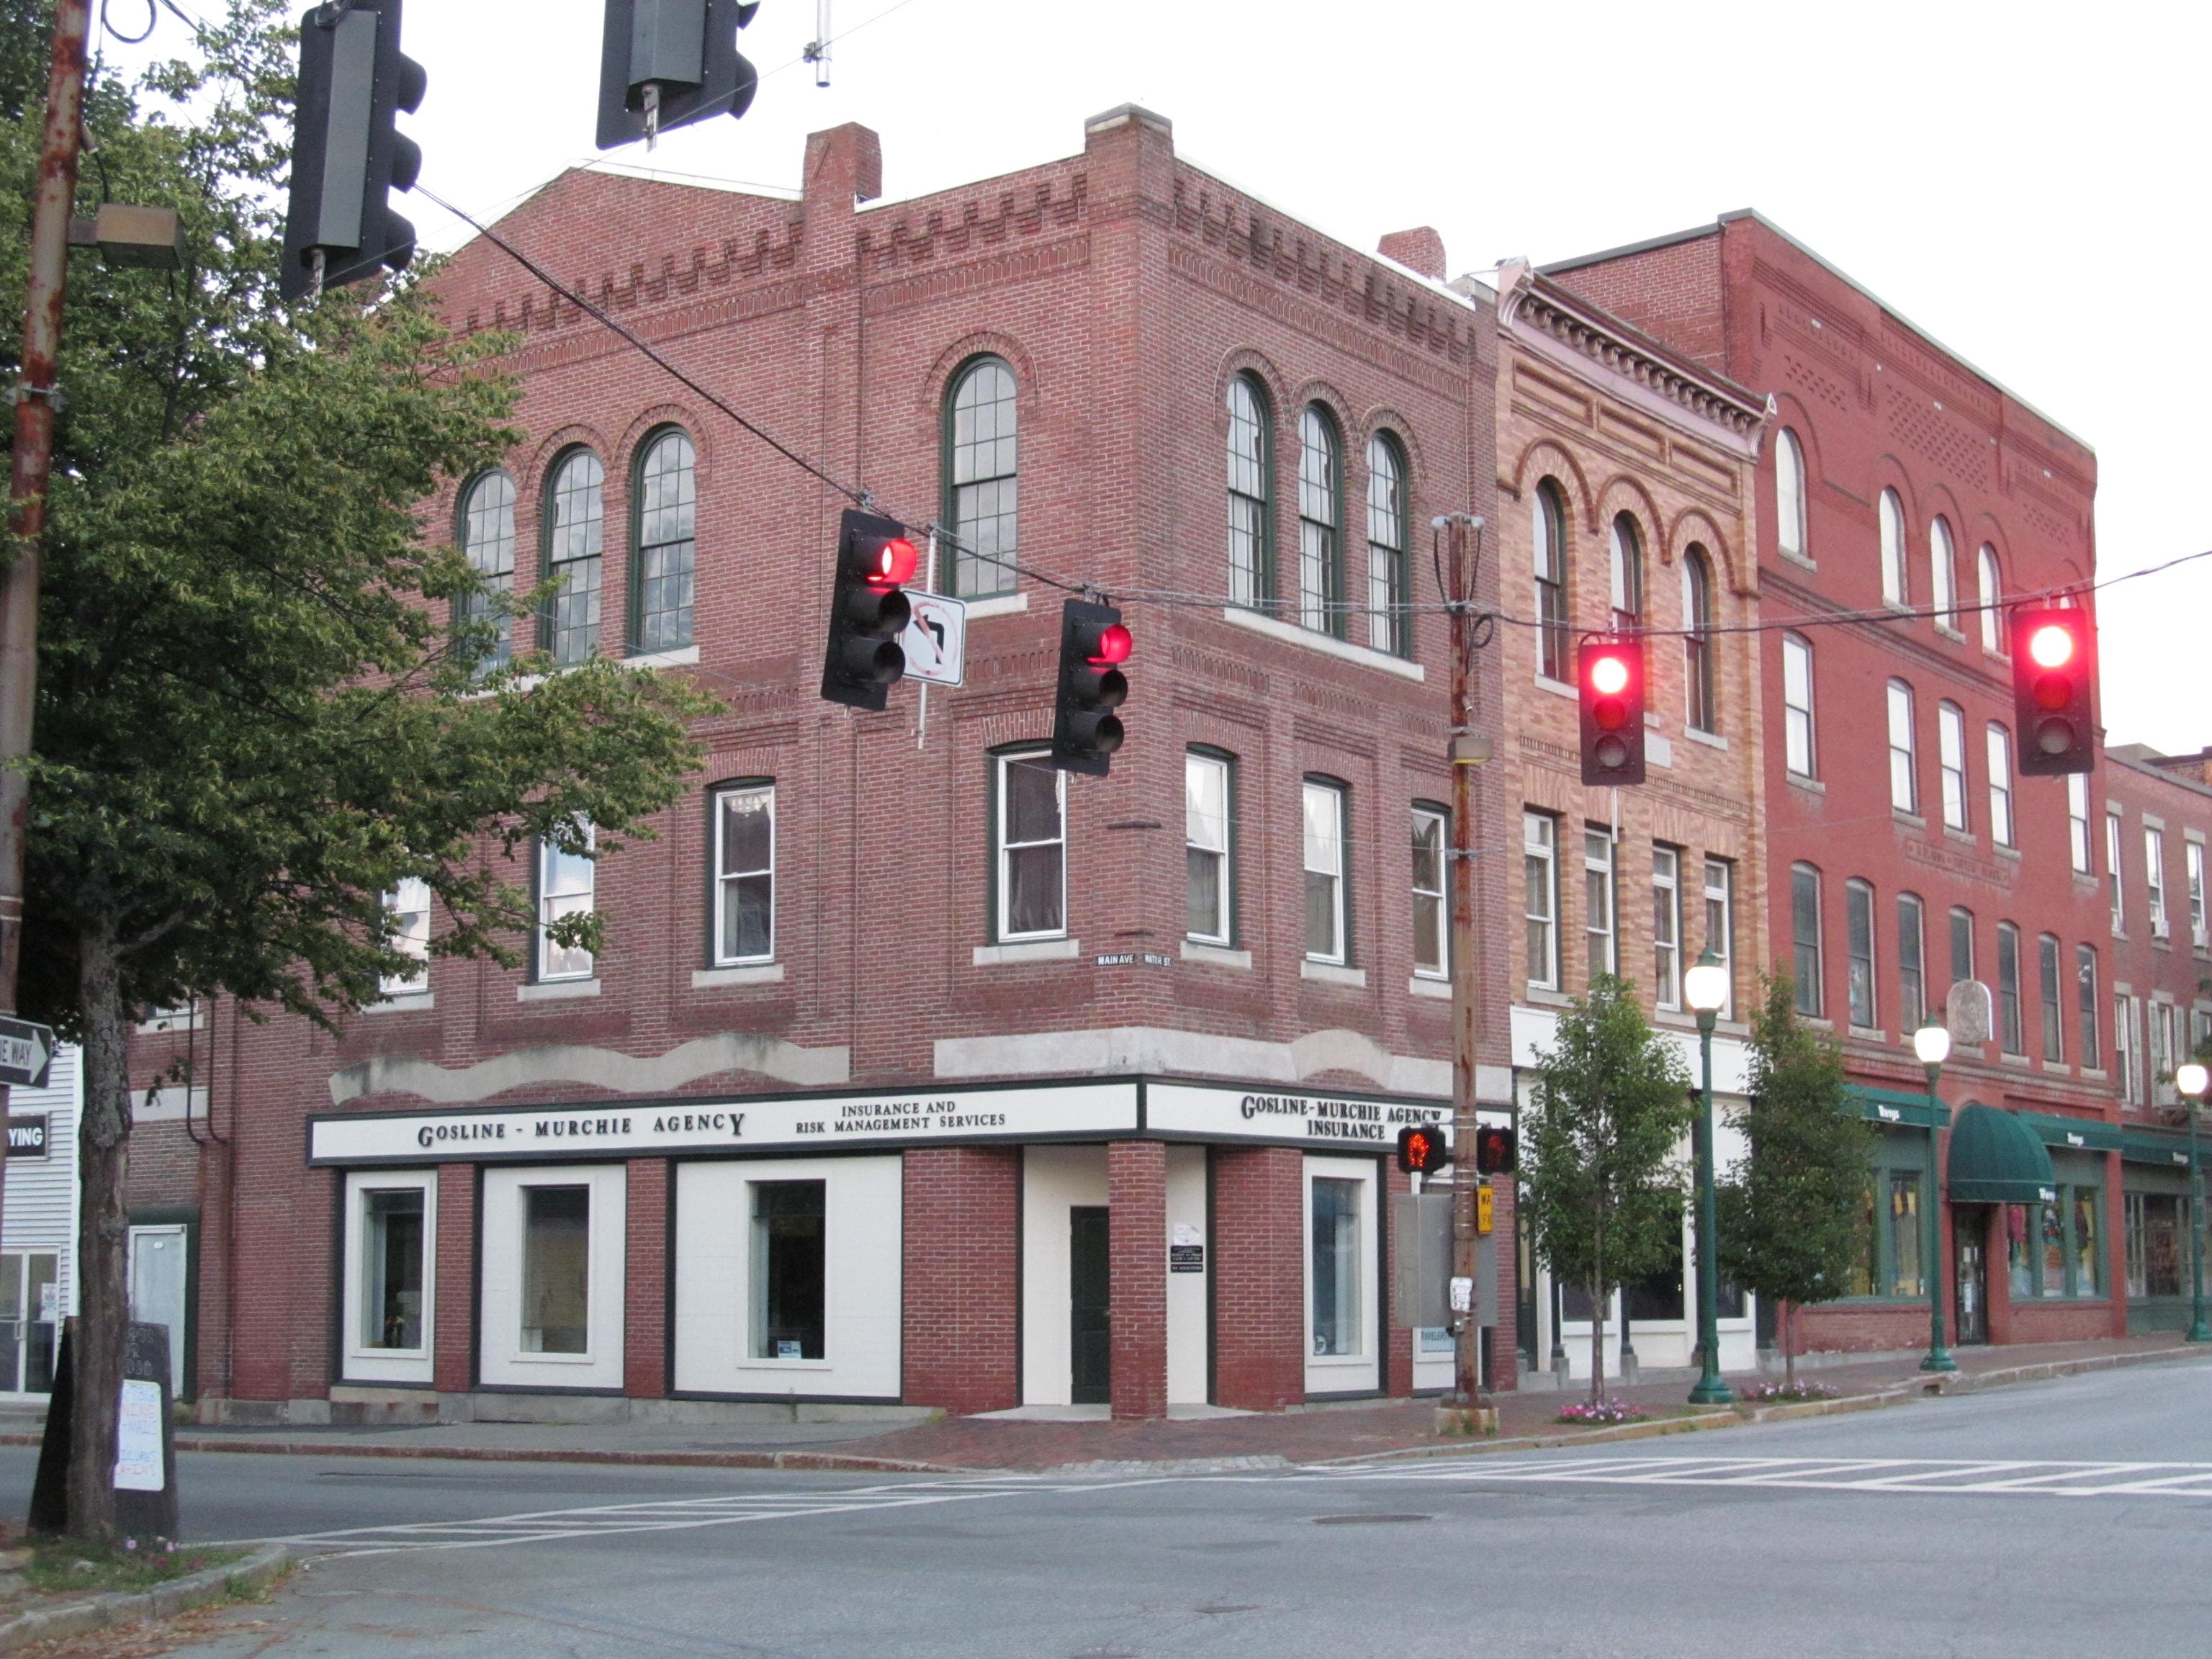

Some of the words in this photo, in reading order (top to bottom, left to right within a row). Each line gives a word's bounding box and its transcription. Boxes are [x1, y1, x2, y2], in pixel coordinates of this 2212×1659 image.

[1097, 956, 1118, 966] MAIN
[11, 1040, 32, 1066] WAY
[842, 1102, 920, 1117] INSURANCE
[926, 1100, 956, 1114] AND
[418, 1123, 505, 1148] GOSLINE
[534, 1118, 631, 1136] MURCHIE
[652, 1112, 745, 1136] AGENCY
[796, 1121, 825, 1134] RISK
[834, 1117, 930, 1133] MANAGEMENT
[939, 1113, 1006, 1128] SERVICES
[1307, 1119, 1385, 1140] INSURANCE
[8, 1127, 44, 1146] YING
